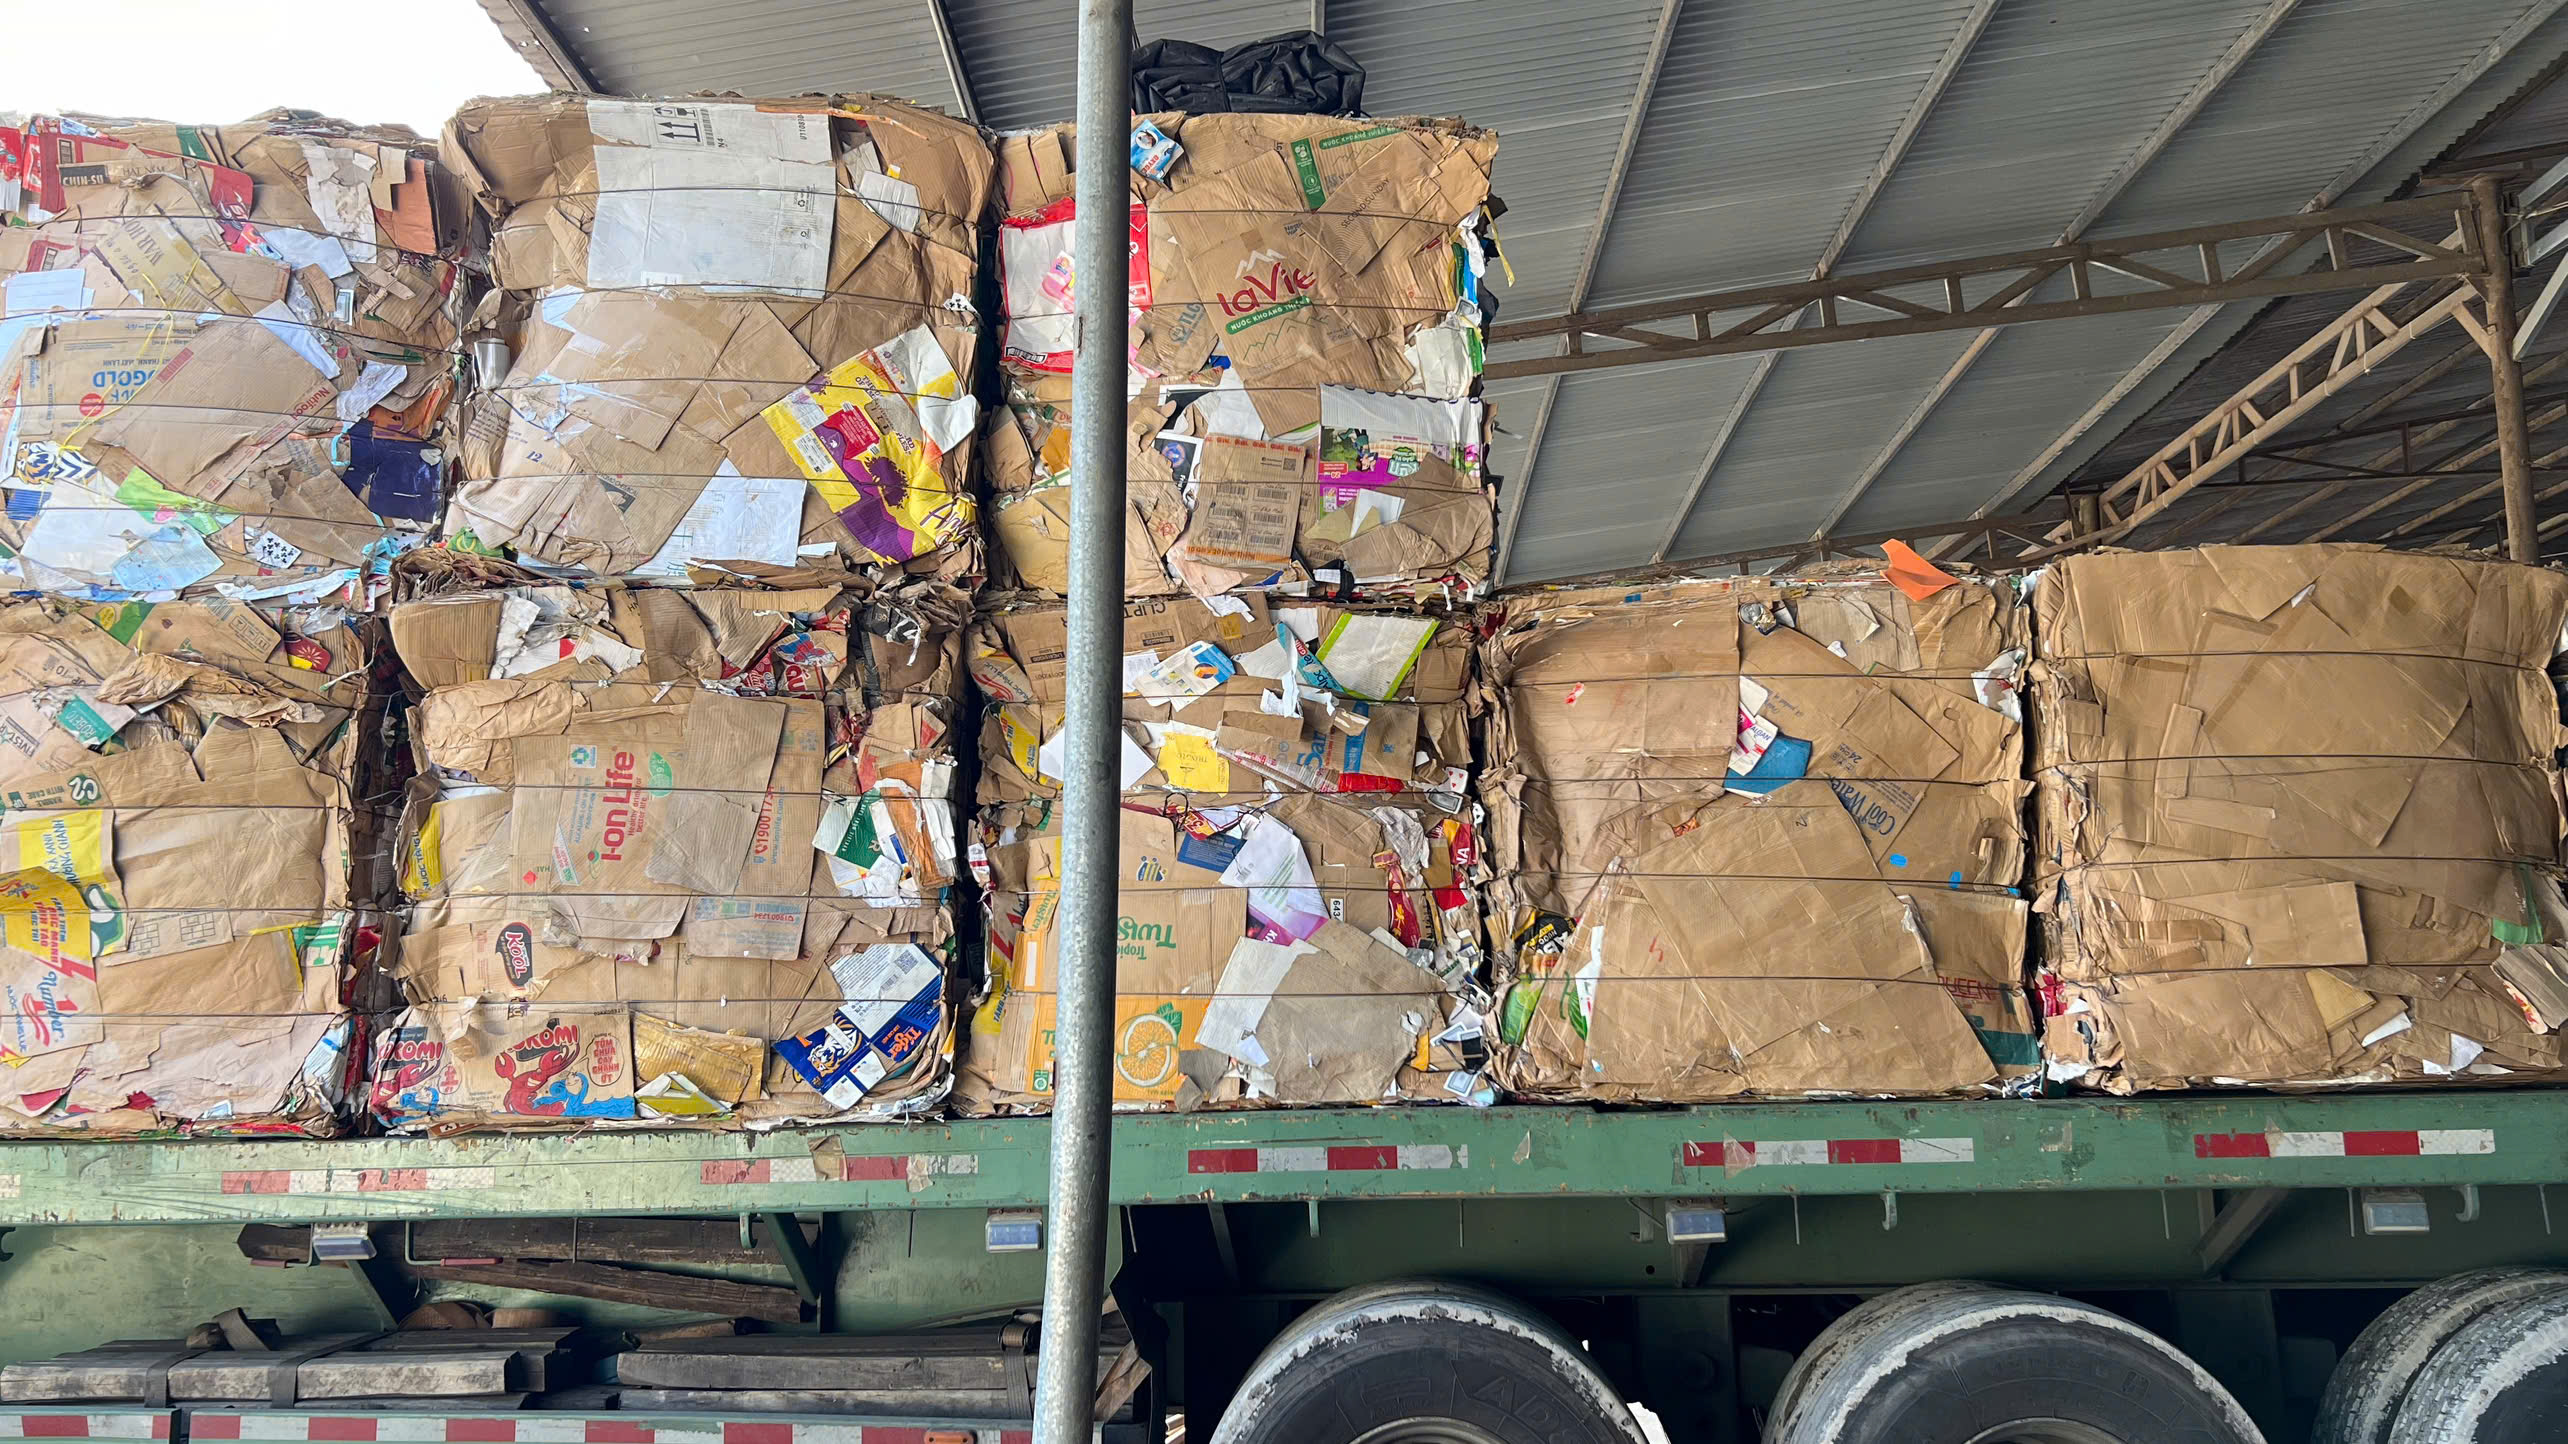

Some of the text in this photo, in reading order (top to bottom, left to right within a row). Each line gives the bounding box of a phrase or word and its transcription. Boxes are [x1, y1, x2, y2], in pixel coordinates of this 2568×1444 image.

[93, 370, 156, 387] GOLD
[1832, 779, 1867, 812] Wate
[888, 1026, 923, 1058] Tiger
